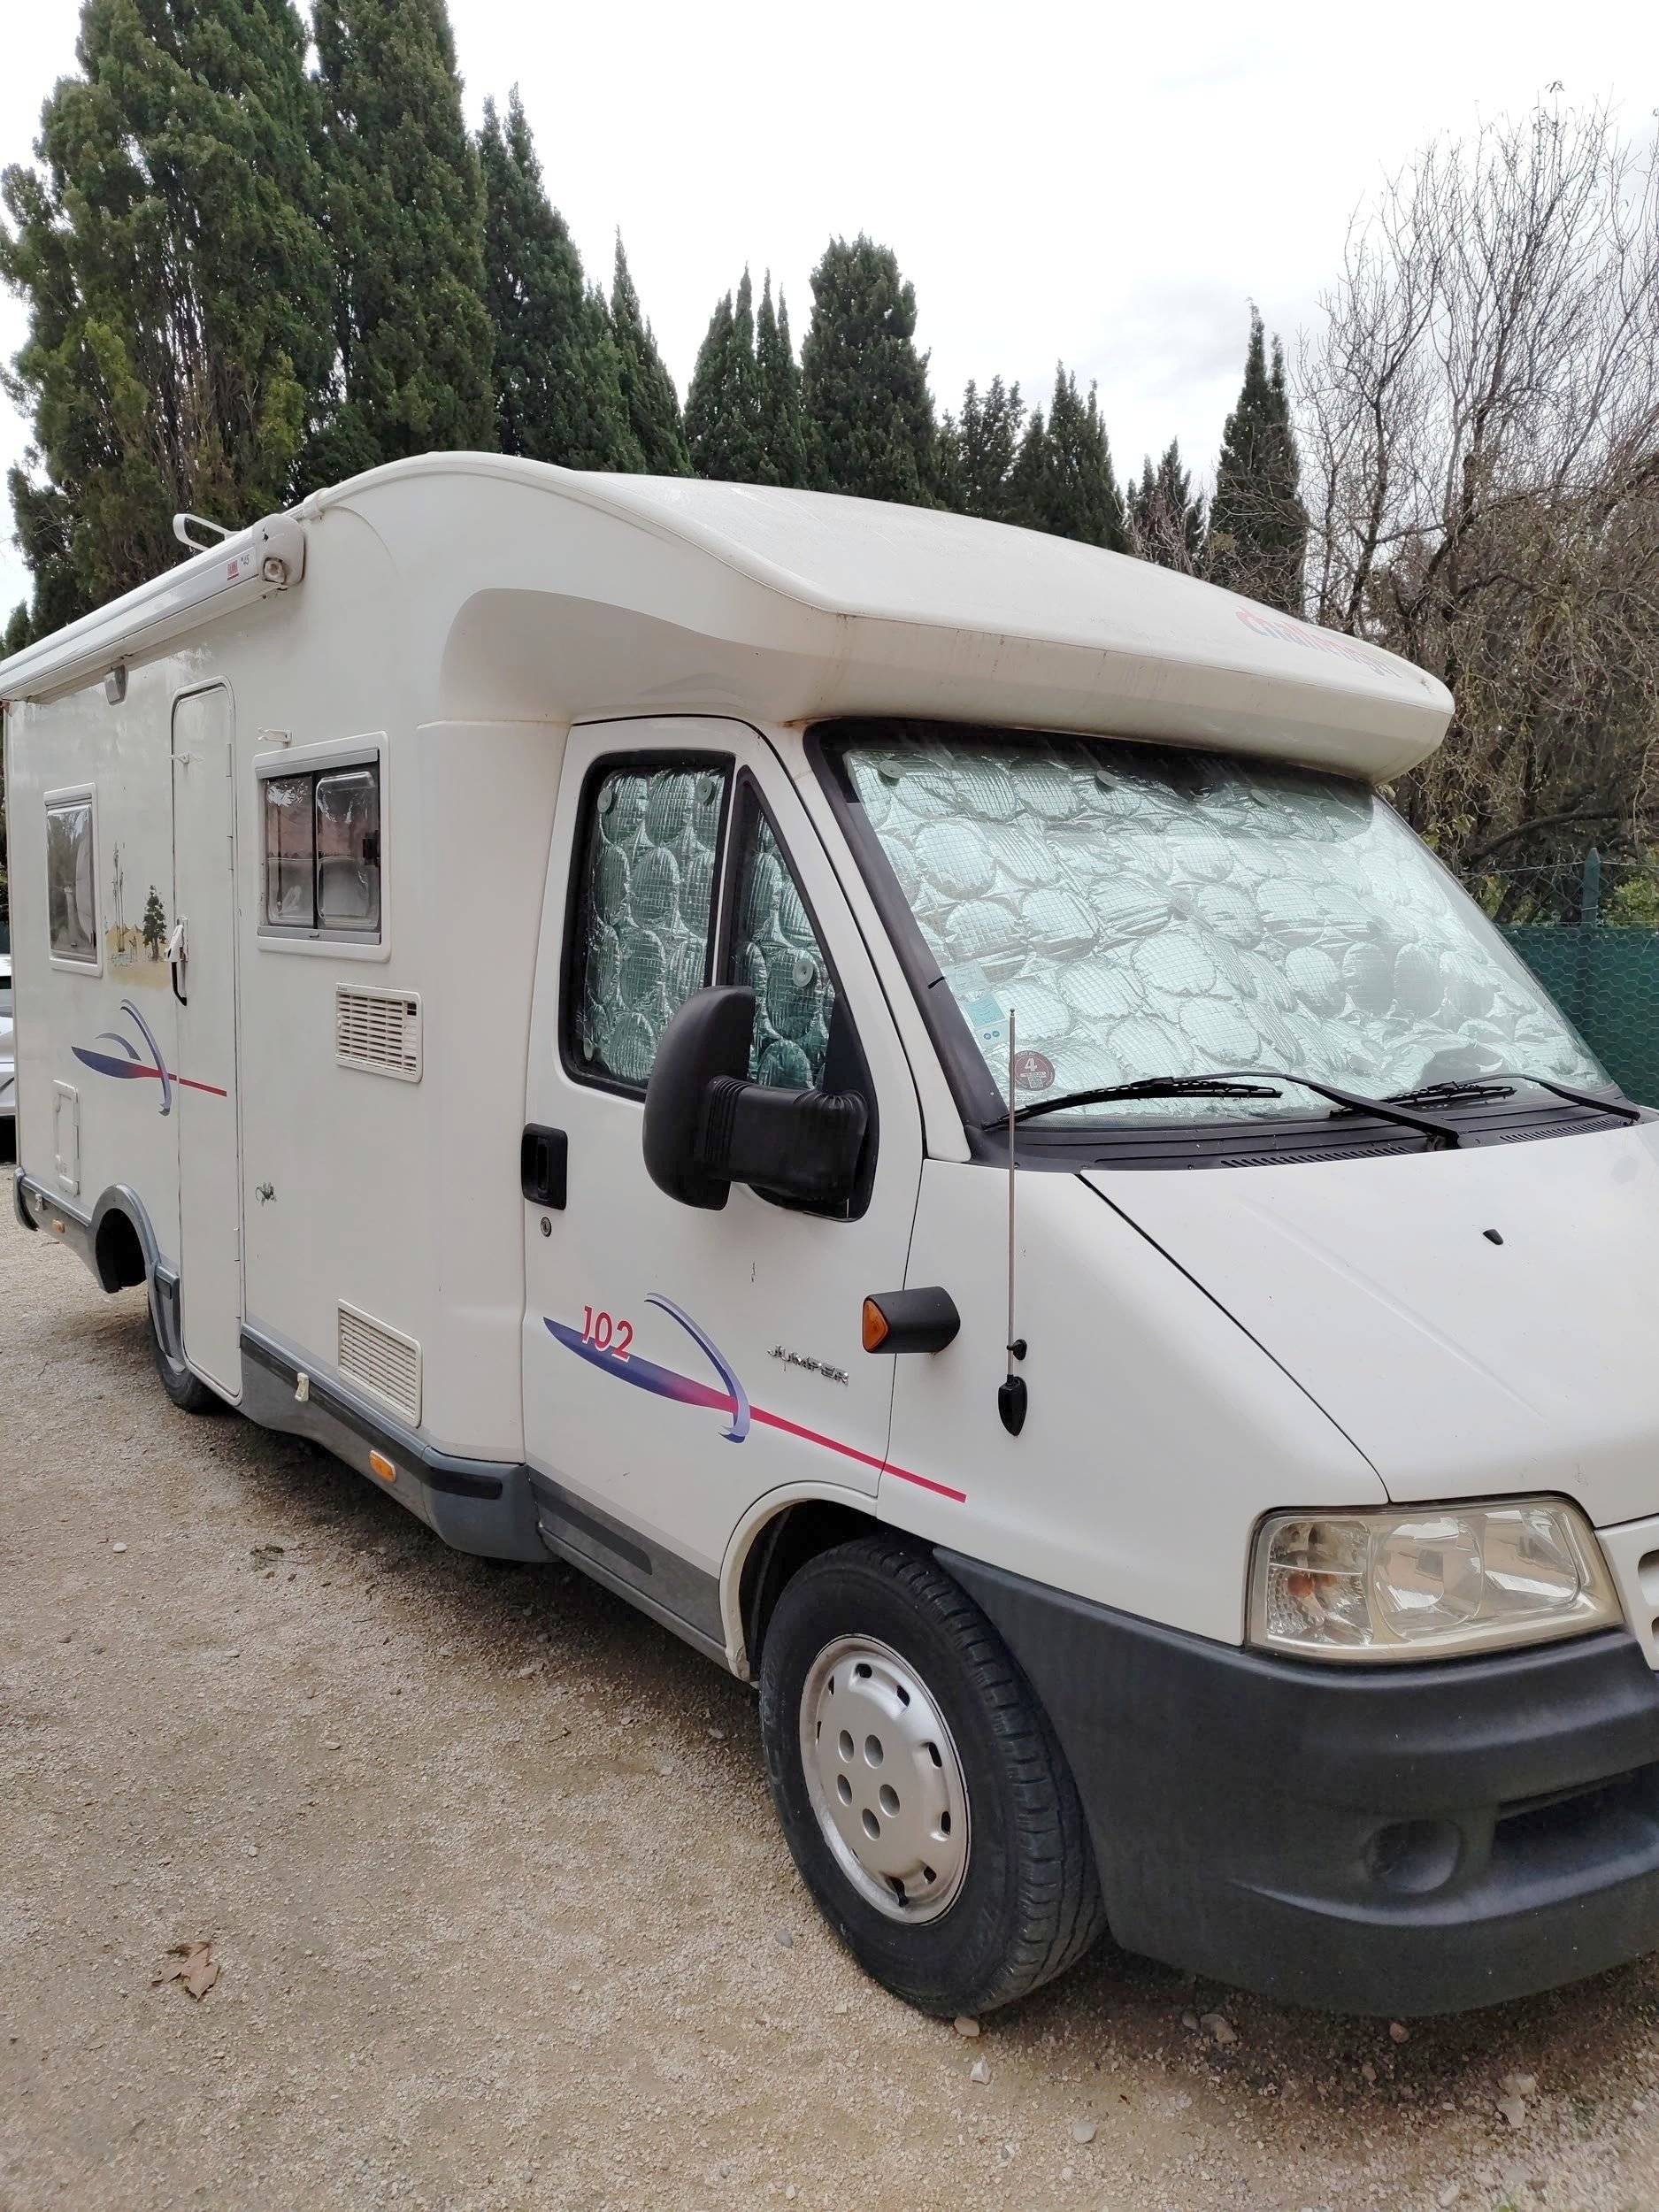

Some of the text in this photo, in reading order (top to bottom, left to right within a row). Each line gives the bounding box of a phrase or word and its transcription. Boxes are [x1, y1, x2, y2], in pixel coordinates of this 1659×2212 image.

[1024, 1057, 1038, 1071] 4
[582, 1305, 634, 1363] 102
[766, 1344, 849, 1386] JUMPER
